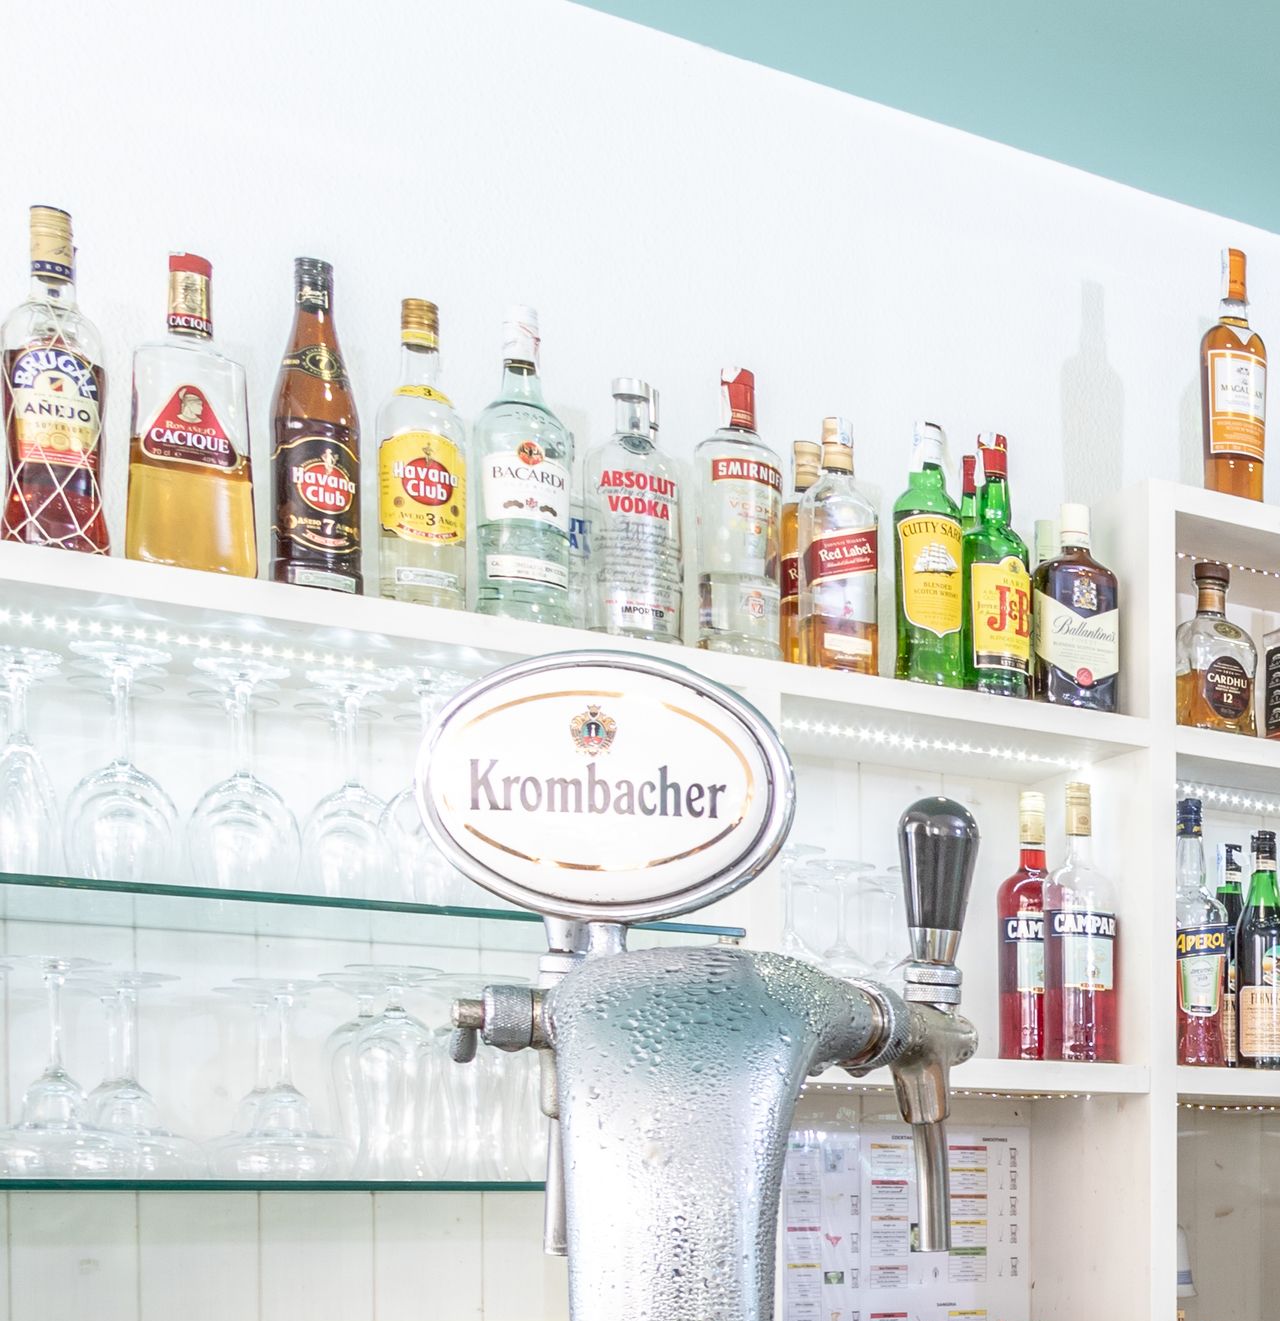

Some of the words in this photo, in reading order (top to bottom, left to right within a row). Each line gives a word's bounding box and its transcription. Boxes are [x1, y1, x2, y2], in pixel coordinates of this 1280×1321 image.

[14, 350, 97, 398] BRUGAL
[24, 399, 91, 423] AÑEJO
[150, 427, 230, 454] CACIQUE
[292, 466, 356, 494] Havana
[394, 461, 458, 487] Havana
[492, 465, 565, 491] BACARDI
[600, 470, 676, 498] ABSOLUT
[306, 487, 346, 506] Club
[407, 480, 447, 501] Club
[425, 513, 436, 527] 3
[608, 496, 669, 521] VODKA
[322, 519, 336, 535] 7
[902, 521, 939, 540] CUTTY
[819, 545, 842, 562] Red
[843, 543, 873, 558] Label
[1052, 614, 1116, 642] Ballantine's
[1207, 672, 1248, 689] CARDHU
[1223, 692, 1233, 704] 12
[469, 758, 727, 819] Krombacher
[1177, 931, 1225, 954] APEROL
